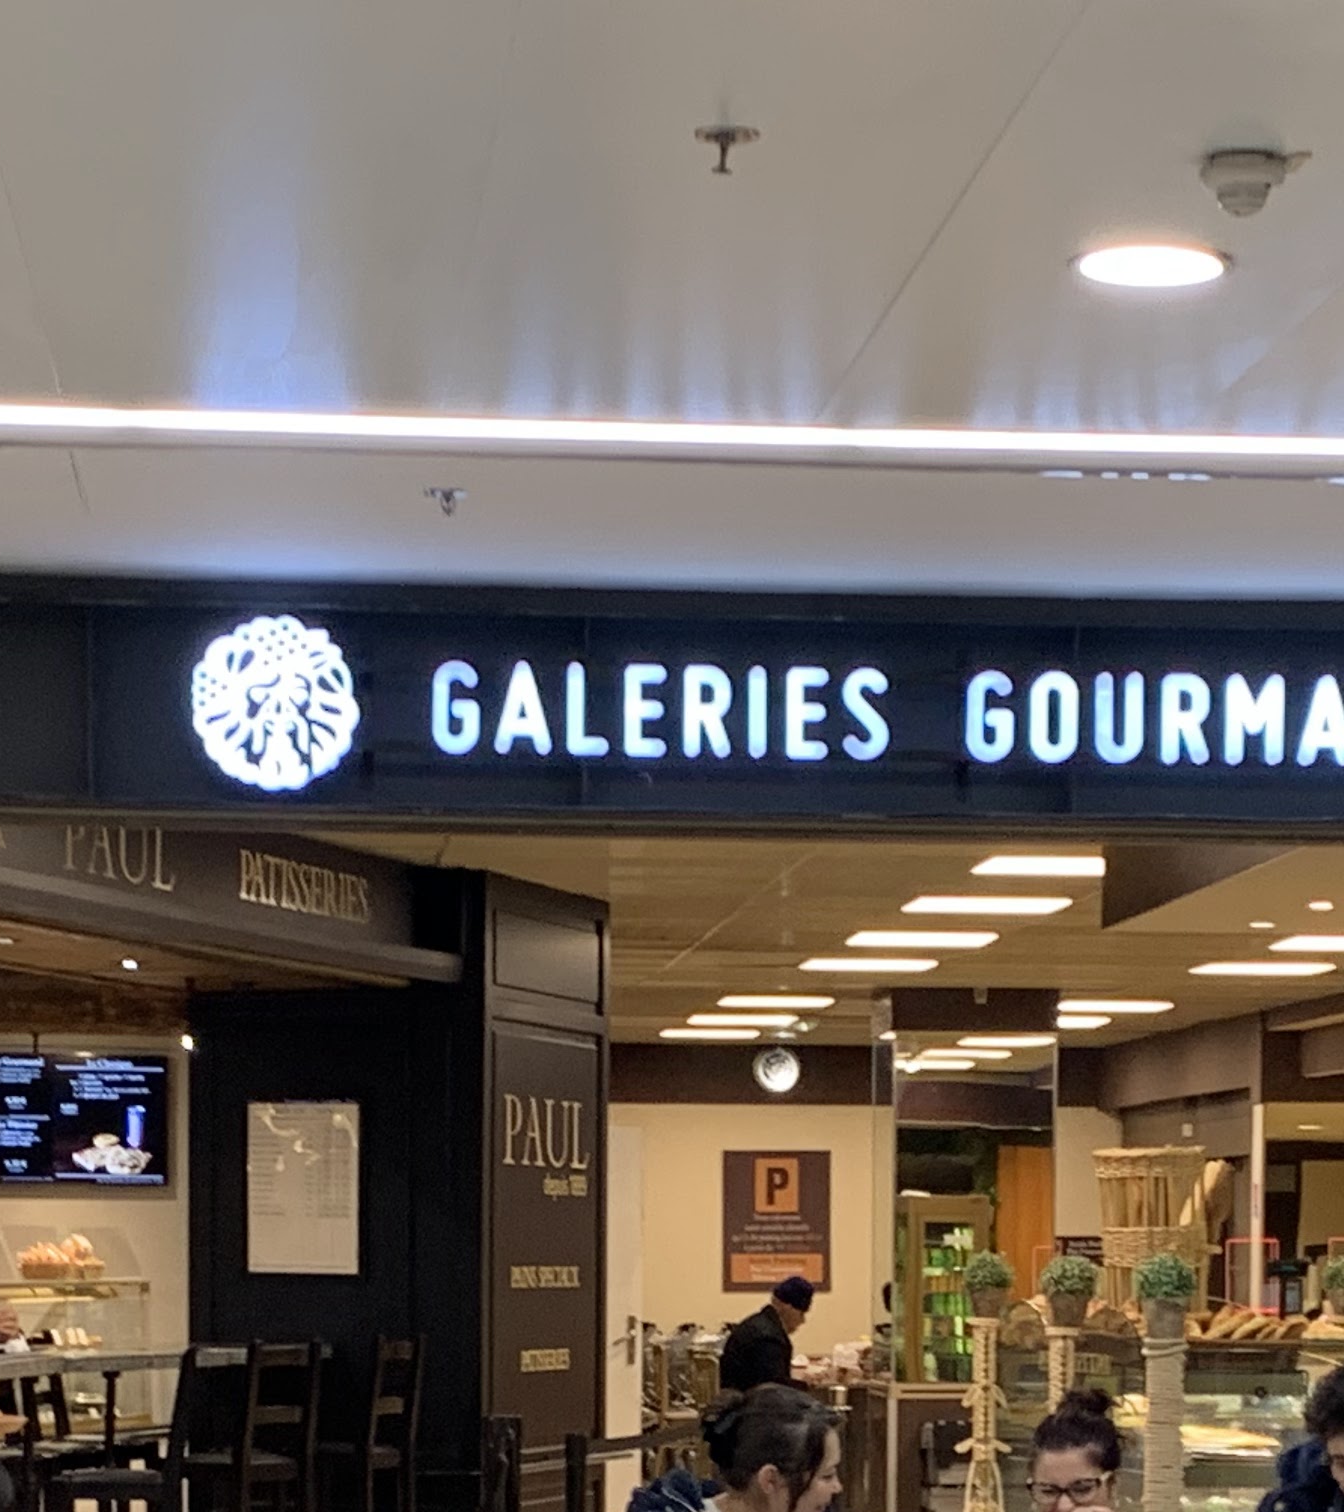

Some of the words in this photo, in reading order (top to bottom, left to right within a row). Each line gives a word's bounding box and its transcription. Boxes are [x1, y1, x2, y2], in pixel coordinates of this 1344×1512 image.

[431, 659, 891, 761] GALERIES
[238, 848, 369, 924] PATISSERIES
[502, 1093, 590, 1169] PAUL
[766, 1166, 790, 1206] P
